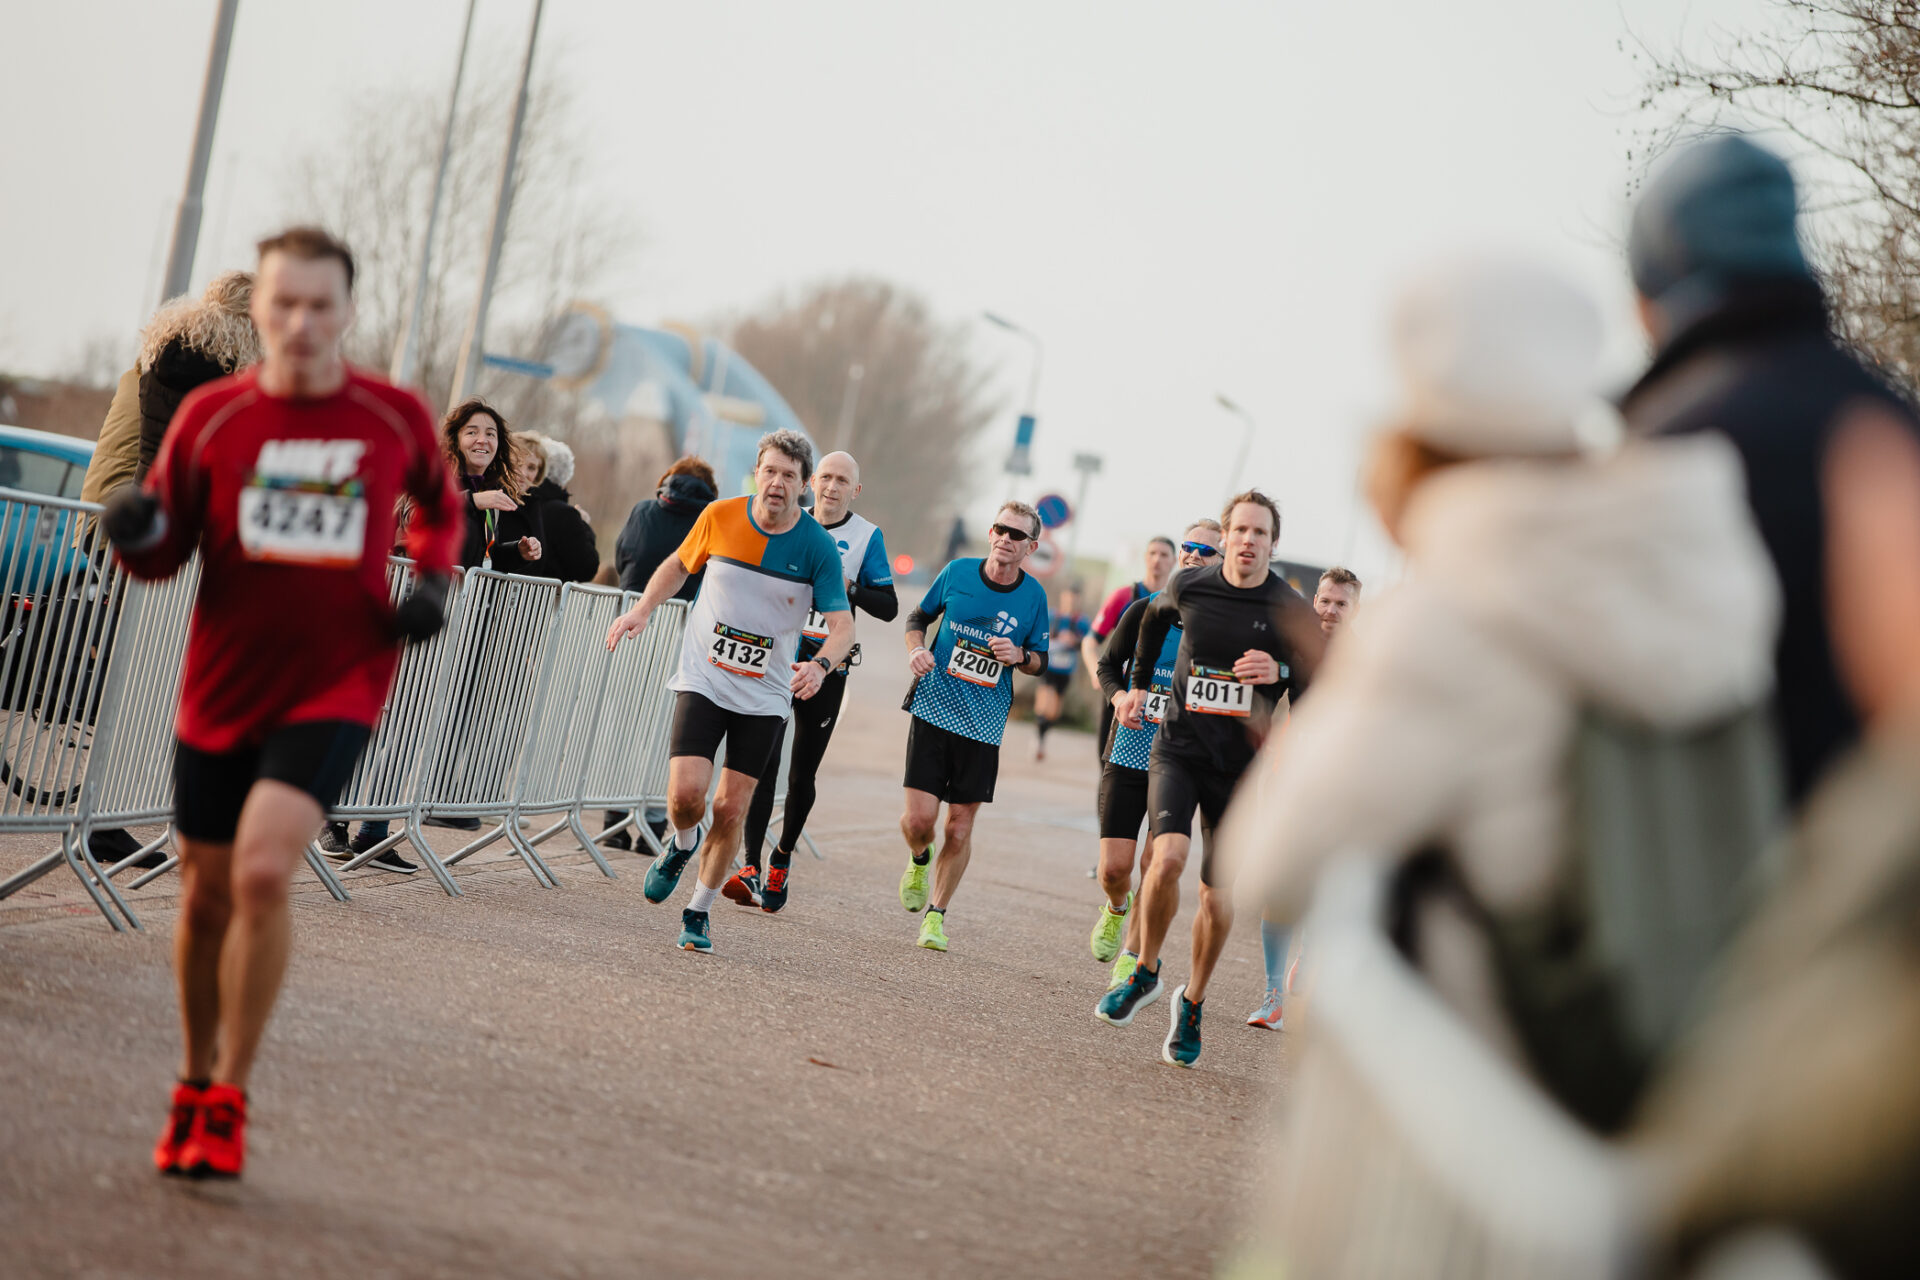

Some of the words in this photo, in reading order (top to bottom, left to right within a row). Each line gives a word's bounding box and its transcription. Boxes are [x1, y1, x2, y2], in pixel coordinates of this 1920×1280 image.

[250, 498, 354, 540] 4247
[950, 620, 994, 642] WARMLO
[713, 638, 766, 668] 4132
[954, 650, 999, 678] 4200
[1192, 681, 1244, 705] 4011
